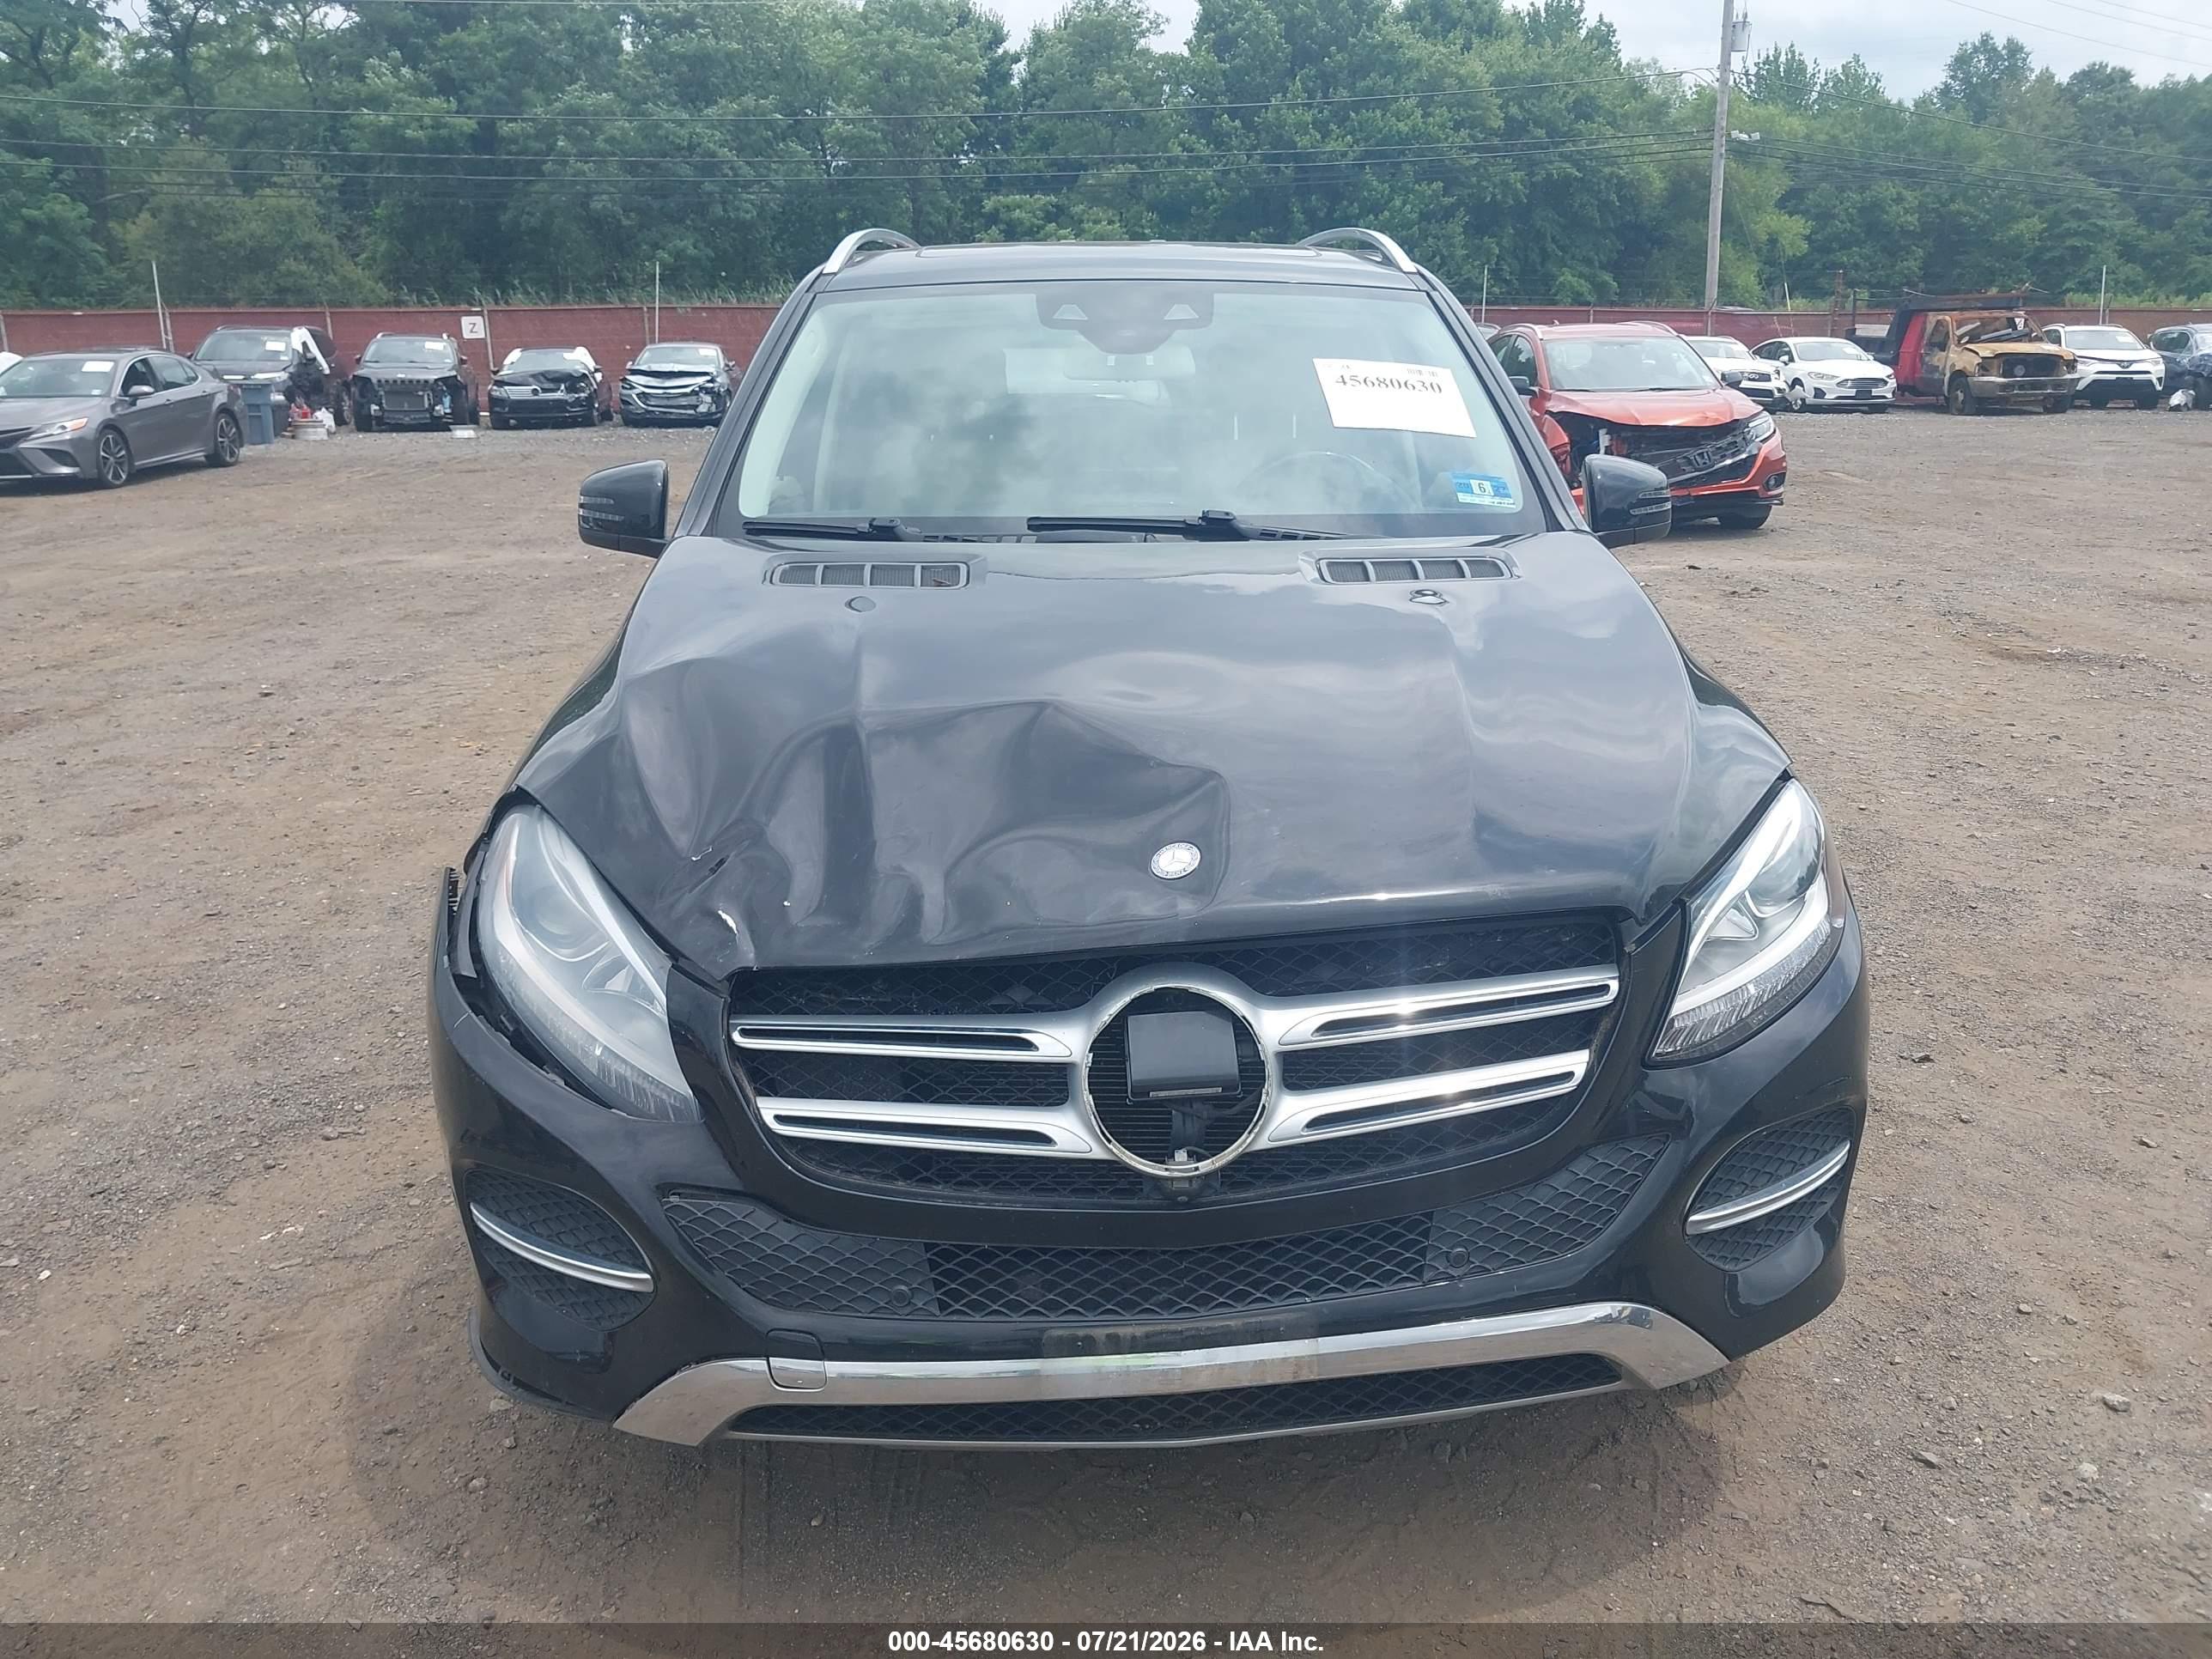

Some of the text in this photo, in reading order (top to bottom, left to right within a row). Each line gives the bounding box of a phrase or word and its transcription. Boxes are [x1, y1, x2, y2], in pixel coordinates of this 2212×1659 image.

[468, 322, 478, 333] Z
[1334, 374, 1443, 395] 45680630
[1477, 482, 1487, 494] 6
